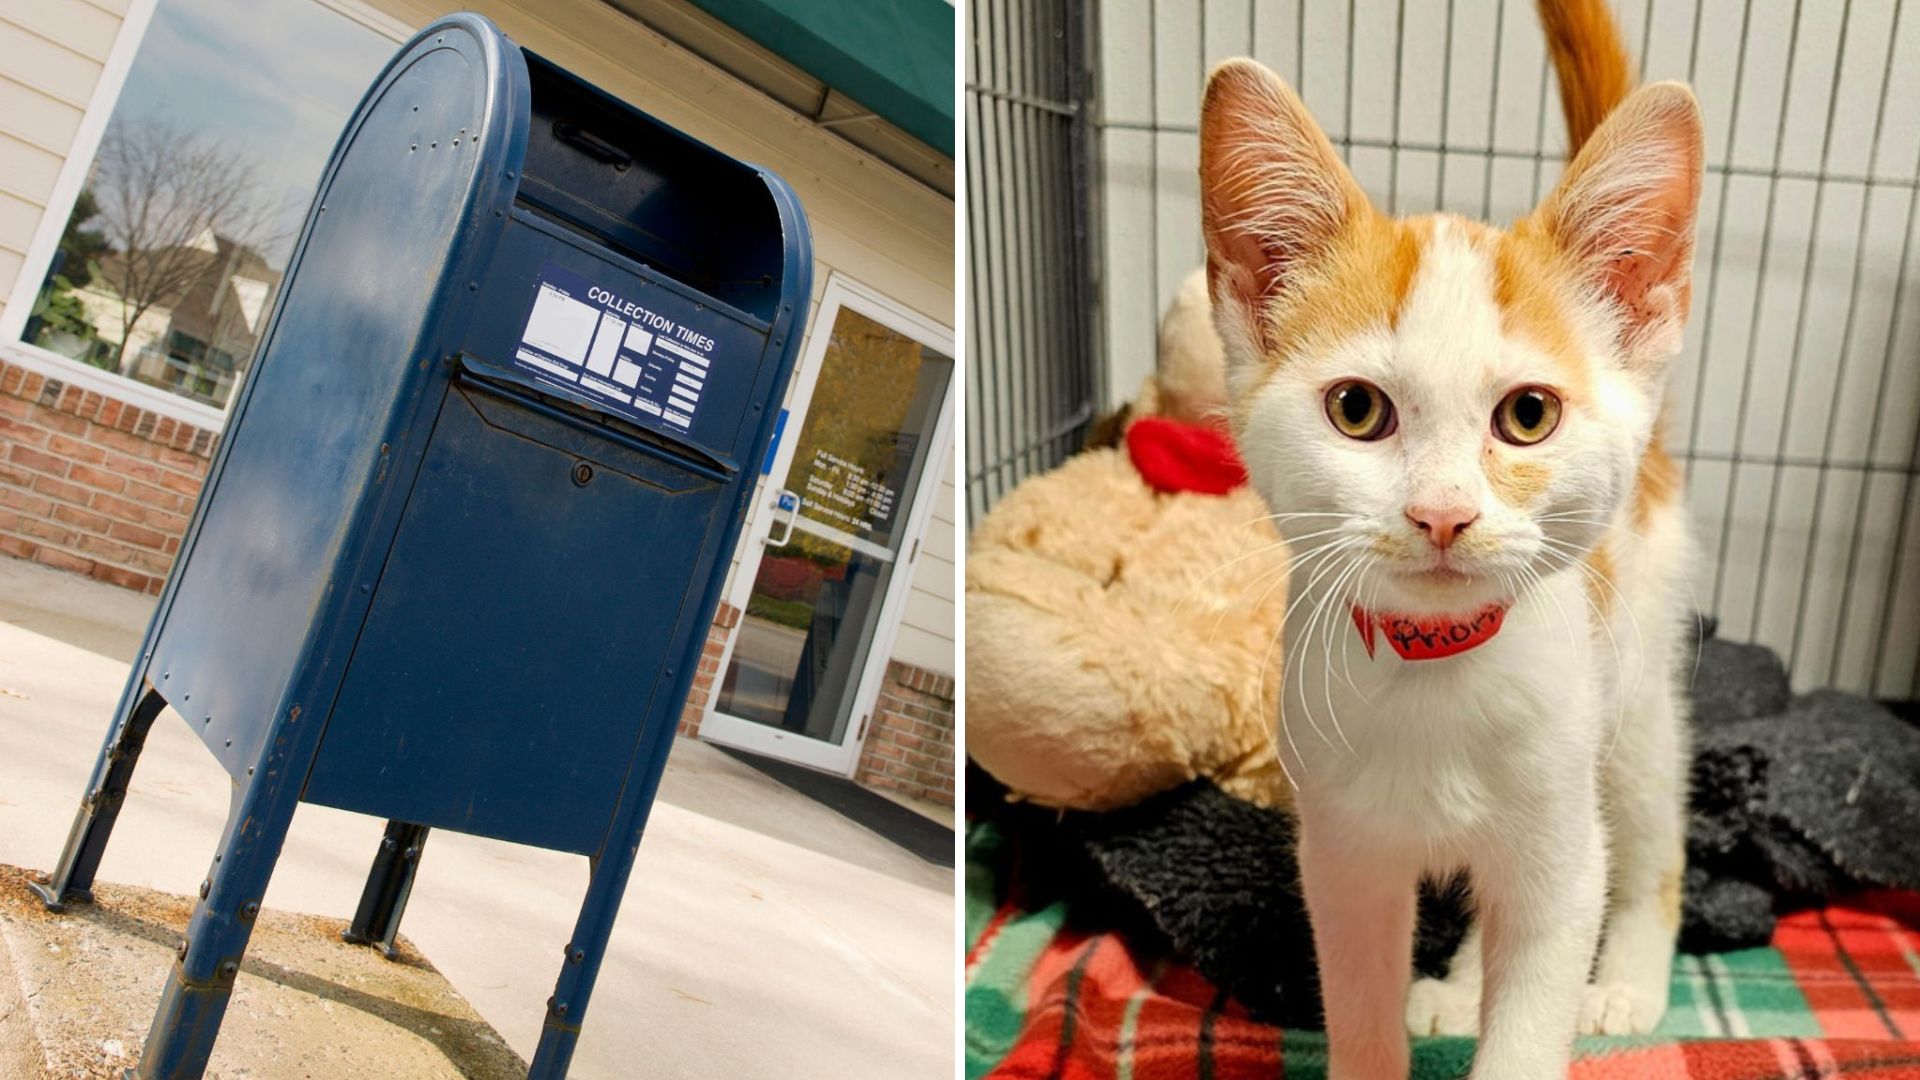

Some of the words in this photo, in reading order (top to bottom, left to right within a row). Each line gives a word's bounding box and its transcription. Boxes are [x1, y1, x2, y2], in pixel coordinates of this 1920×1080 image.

[587, 286, 674, 334] COLLECTION
[677, 325, 714, 351] TIMES
[827, 454, 848, 467] Service
[813, 503, 833, 515] Service
[869, 507, 888, 519] Closed
